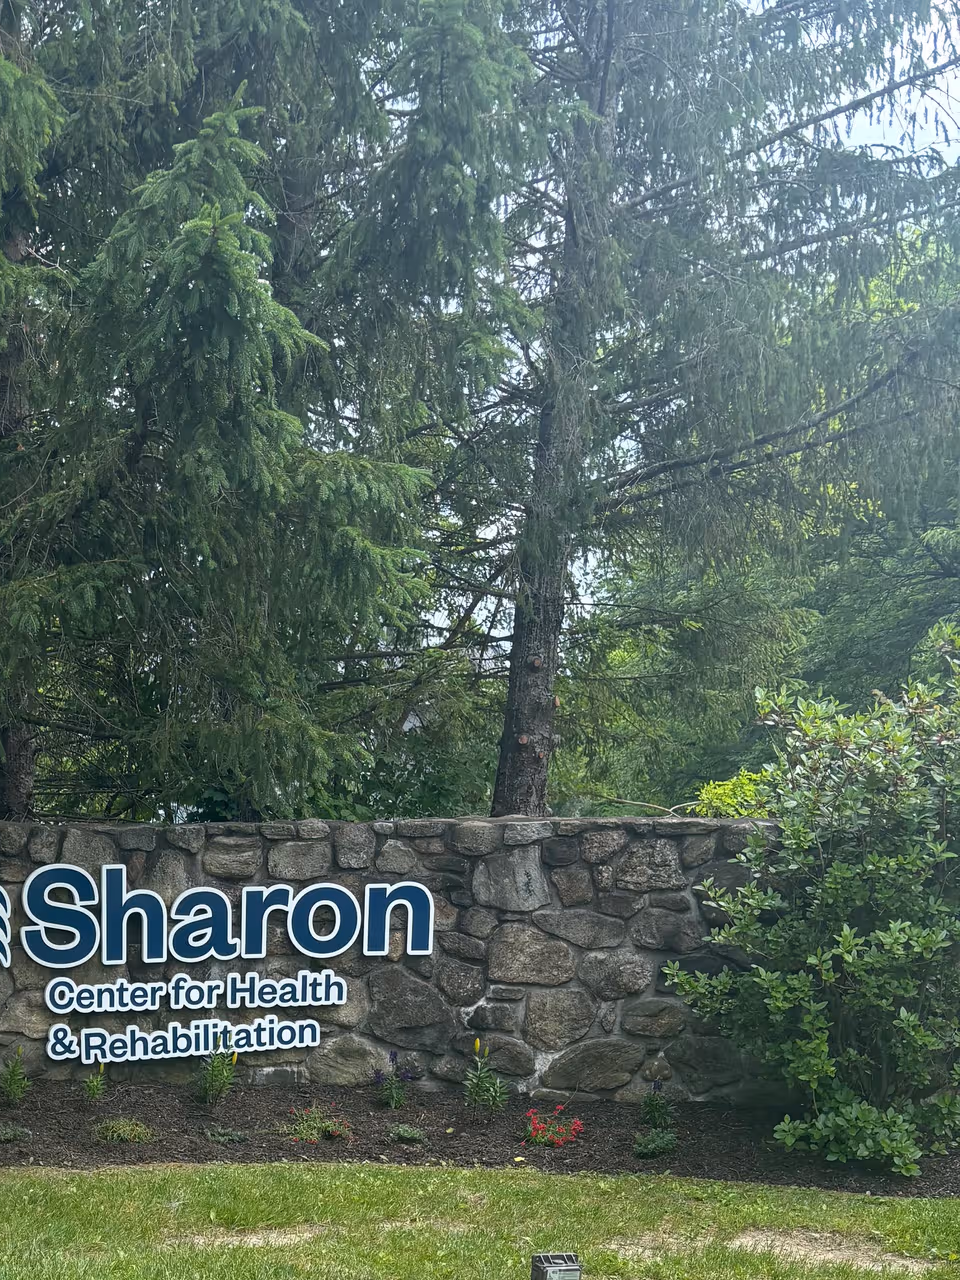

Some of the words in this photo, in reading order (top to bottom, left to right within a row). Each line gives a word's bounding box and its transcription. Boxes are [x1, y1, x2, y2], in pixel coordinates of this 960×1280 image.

[22, 865, 435, 968] Sharon
[47, 978, 165, 1012] Center
[171, 975, 220, 1009] for
[229, 971, 345, 1007] Health
[48, 1025, 76, 1059] &
[83, 1017, 319, 1062] Rehabilitation
